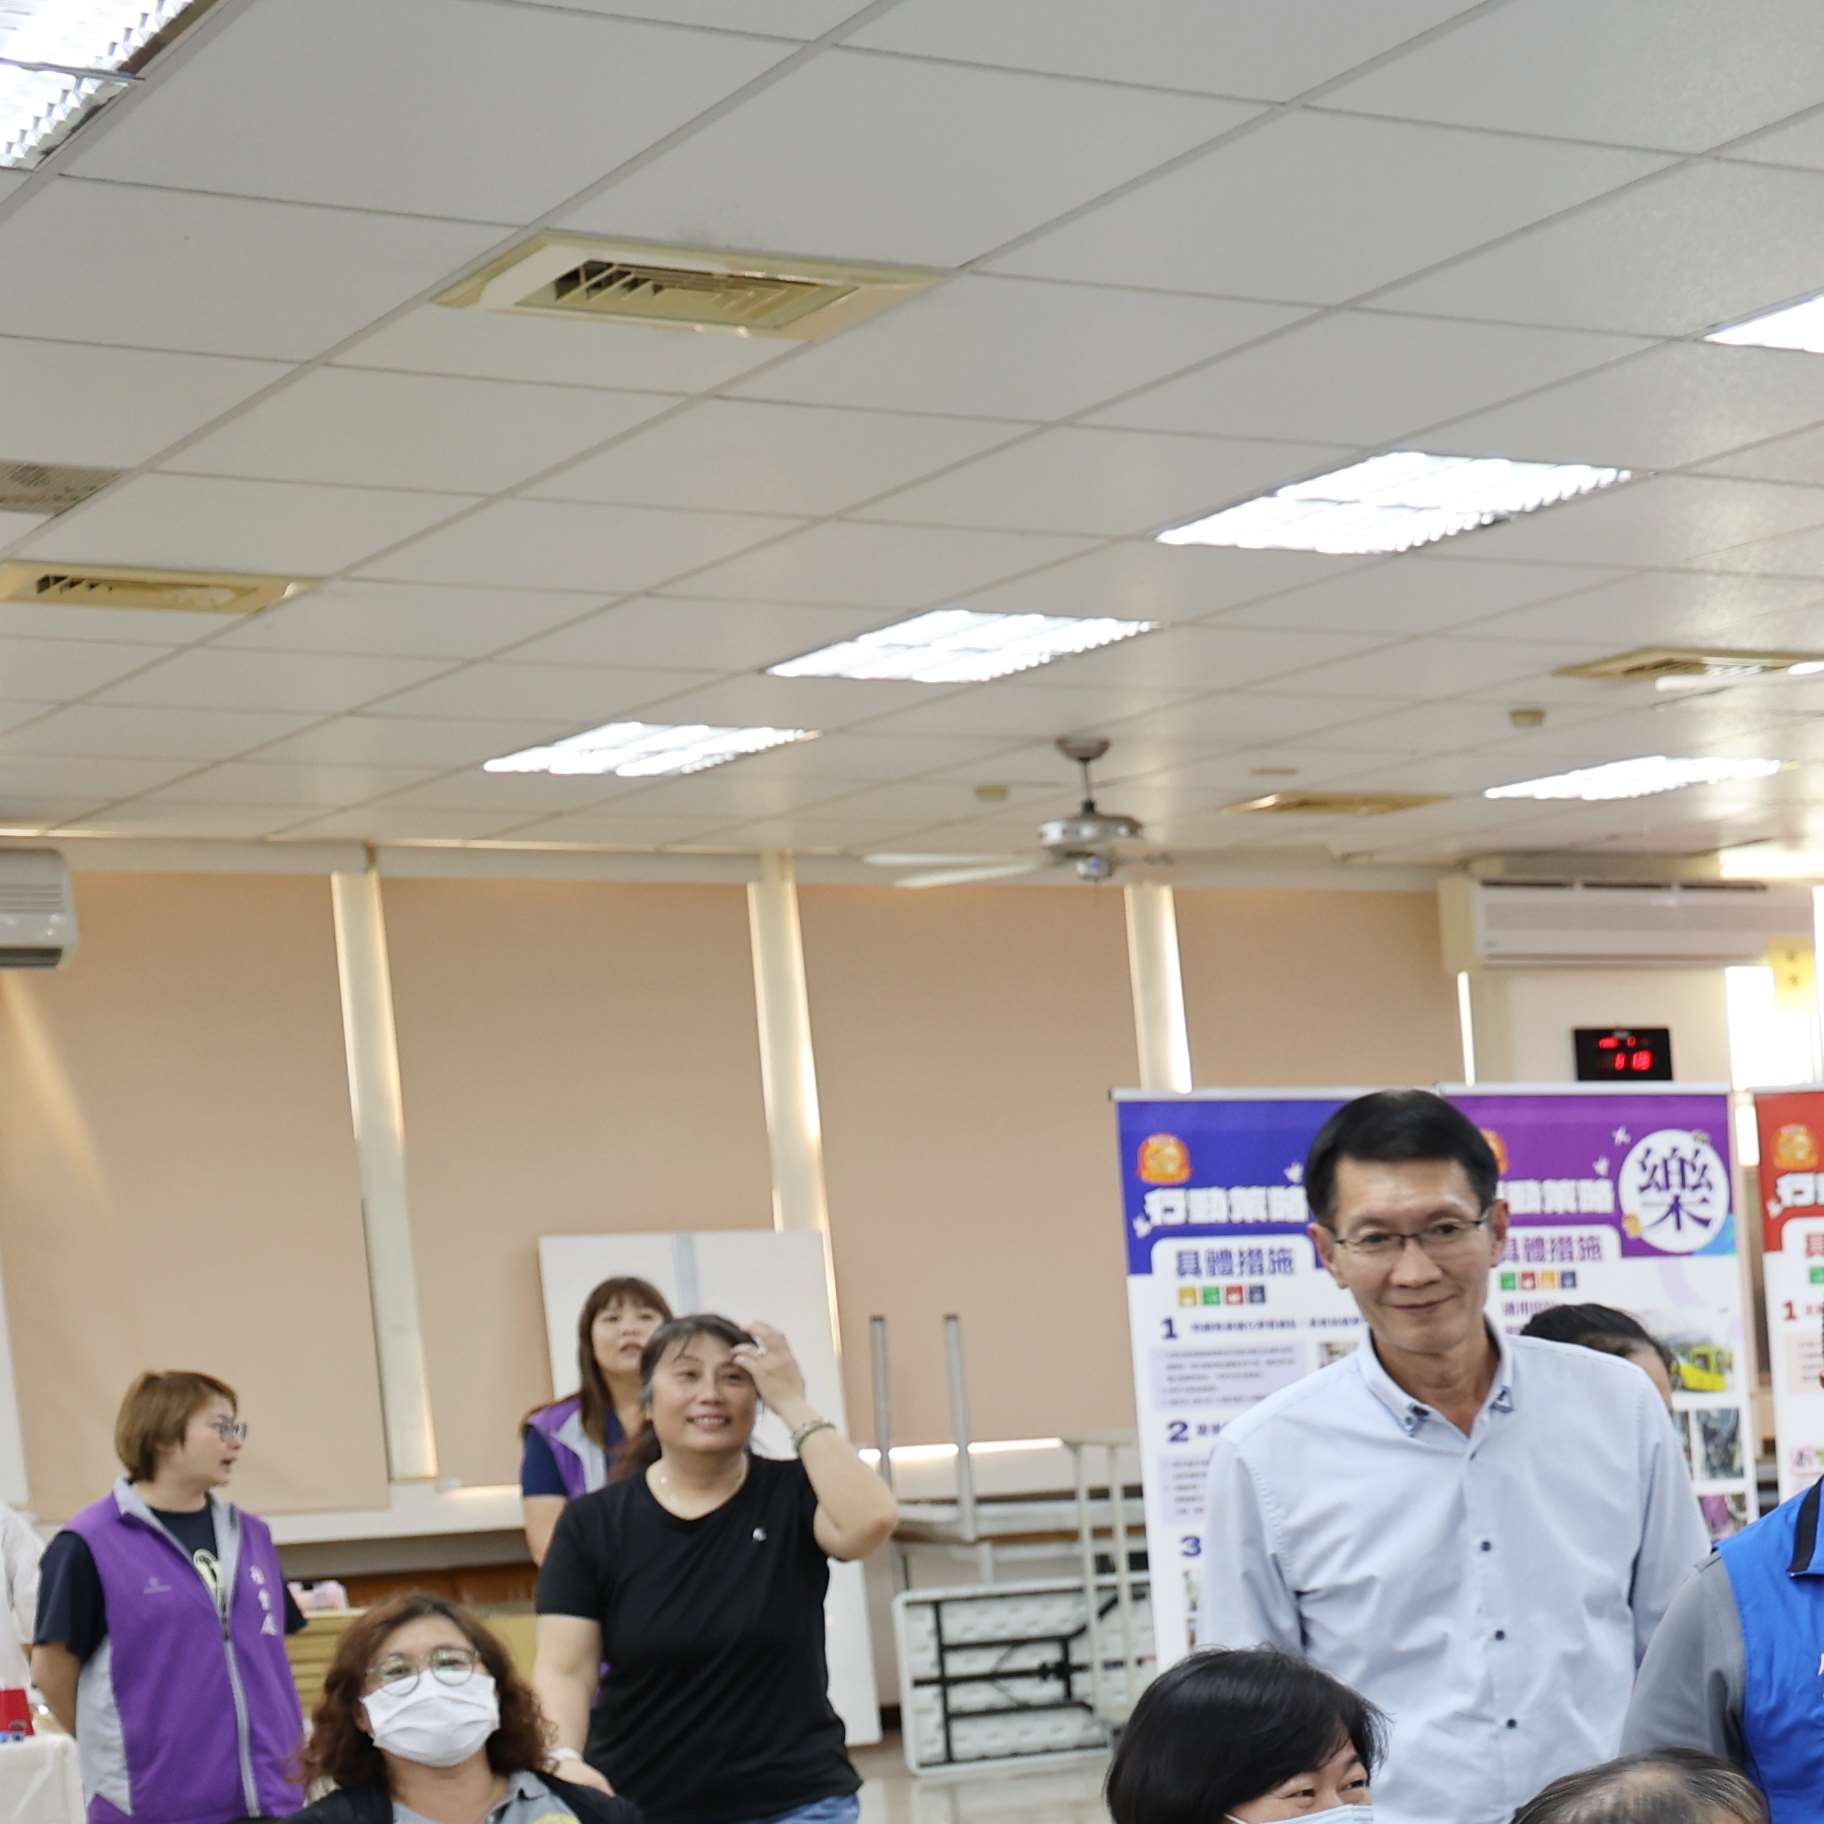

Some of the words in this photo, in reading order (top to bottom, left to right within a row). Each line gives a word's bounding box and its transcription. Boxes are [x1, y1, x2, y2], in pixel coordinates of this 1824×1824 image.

[1636, 1144, 1714, 1233] 樂
[1784, 1300, 1797, 1320] 1
[1161, 1317, 1177, 1340] 1
[1167, 1421, 1190, 1443] 2
[1181, 1536, 1201, 1556] 3
